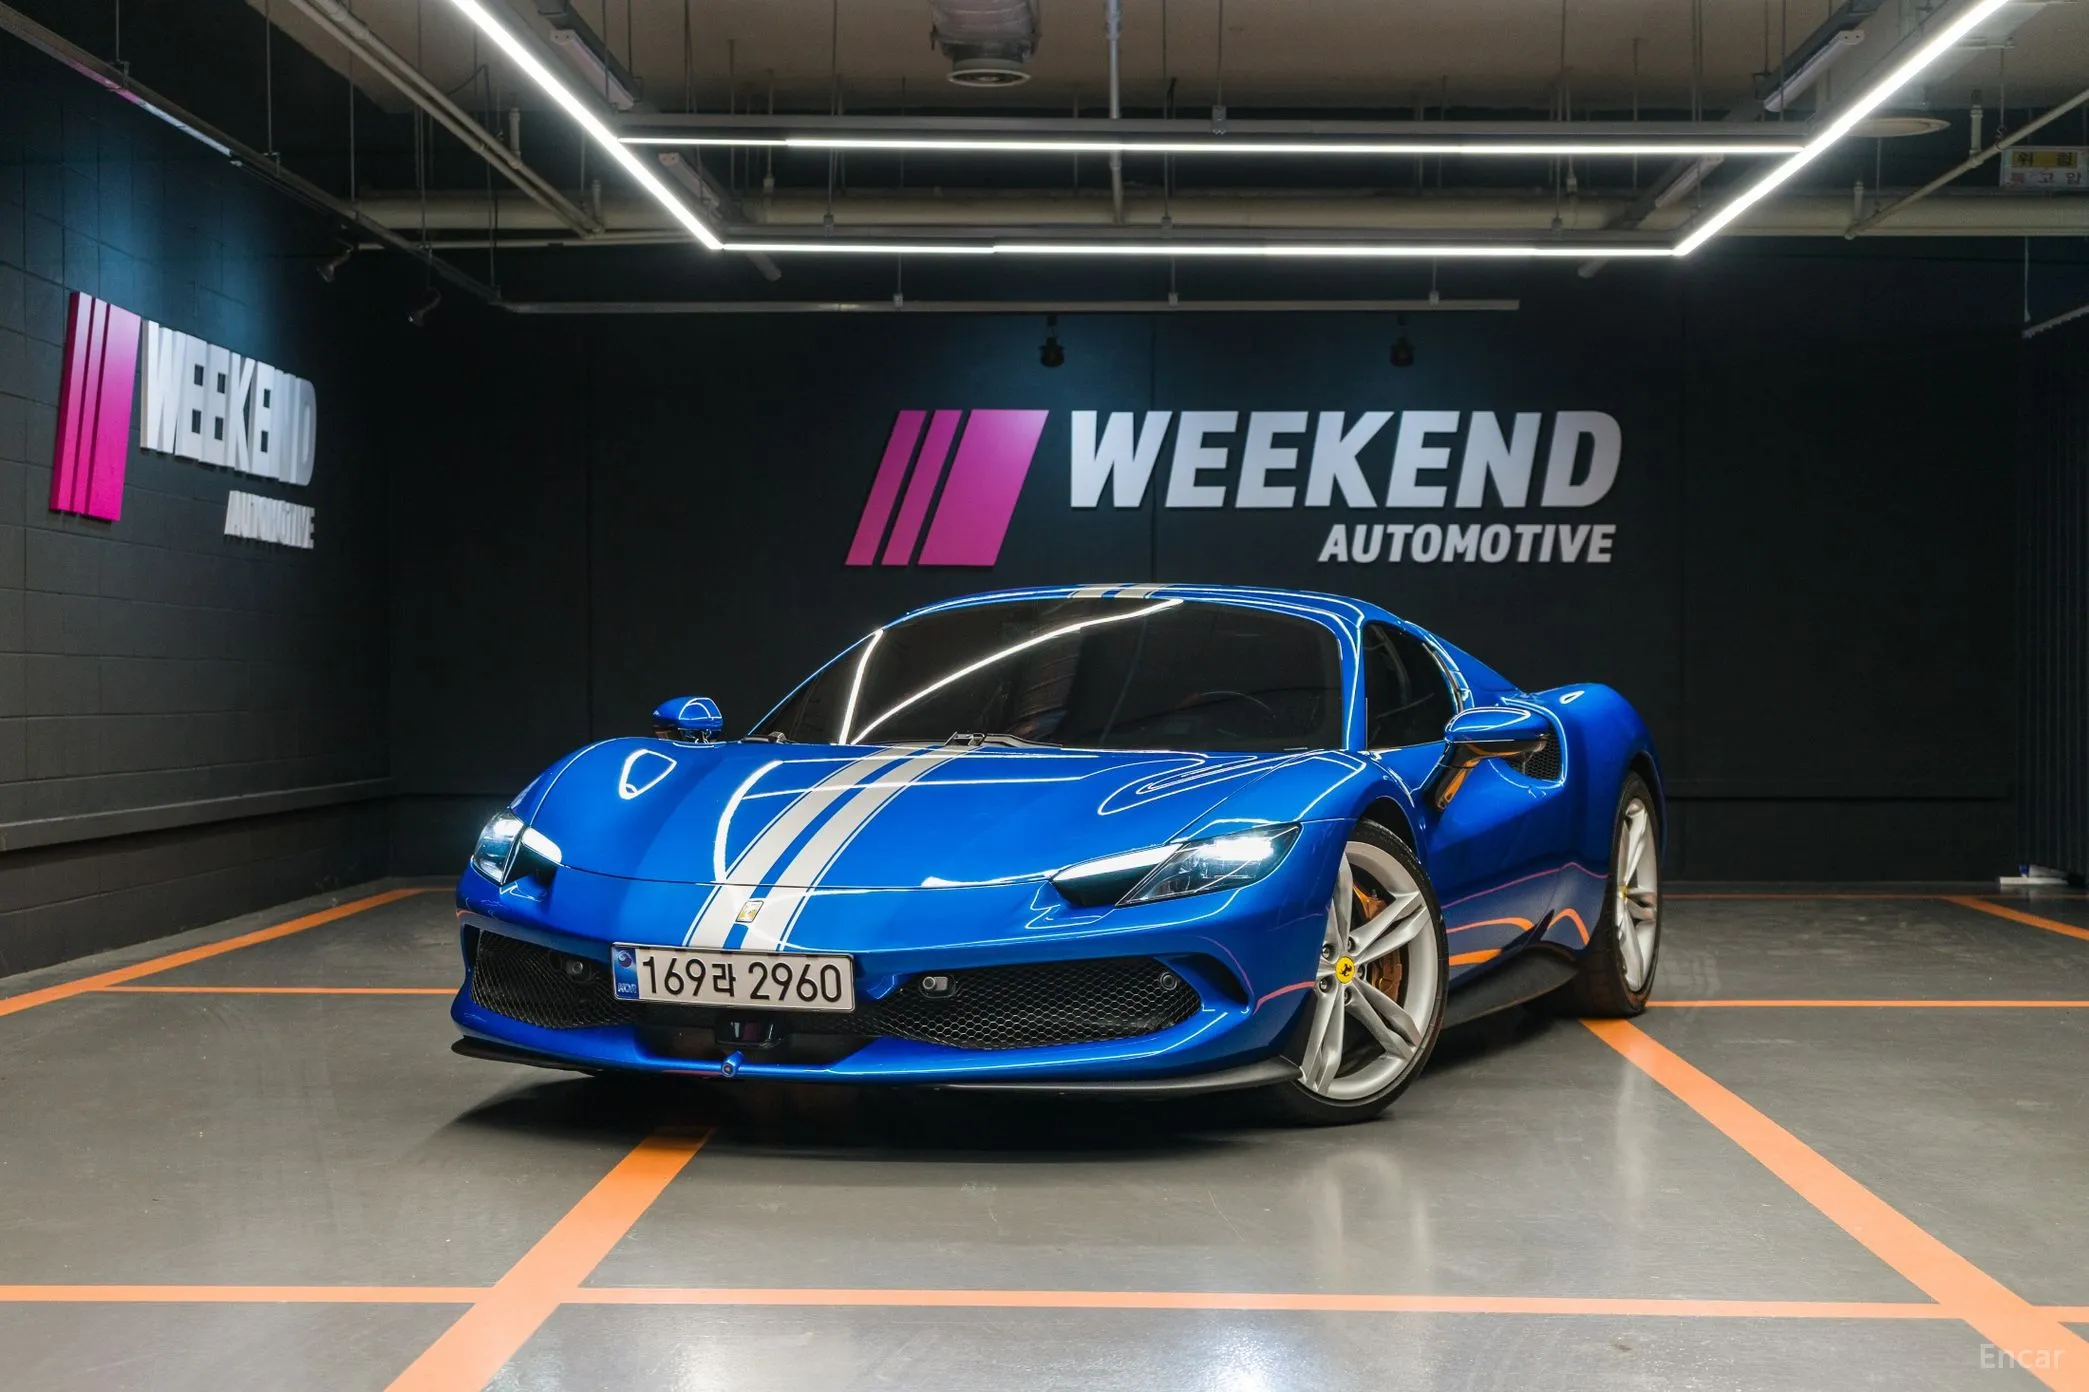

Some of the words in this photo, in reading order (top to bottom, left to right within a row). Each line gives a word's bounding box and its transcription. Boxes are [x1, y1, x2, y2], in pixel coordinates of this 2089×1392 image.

[1070, 410, 1623, 508] WEEKEND
[1317, 523, 1617, 563] AUTOMOTIVE
[642, 955, 737, 998] 169라
[748, 961, 843, 1003] 2960
